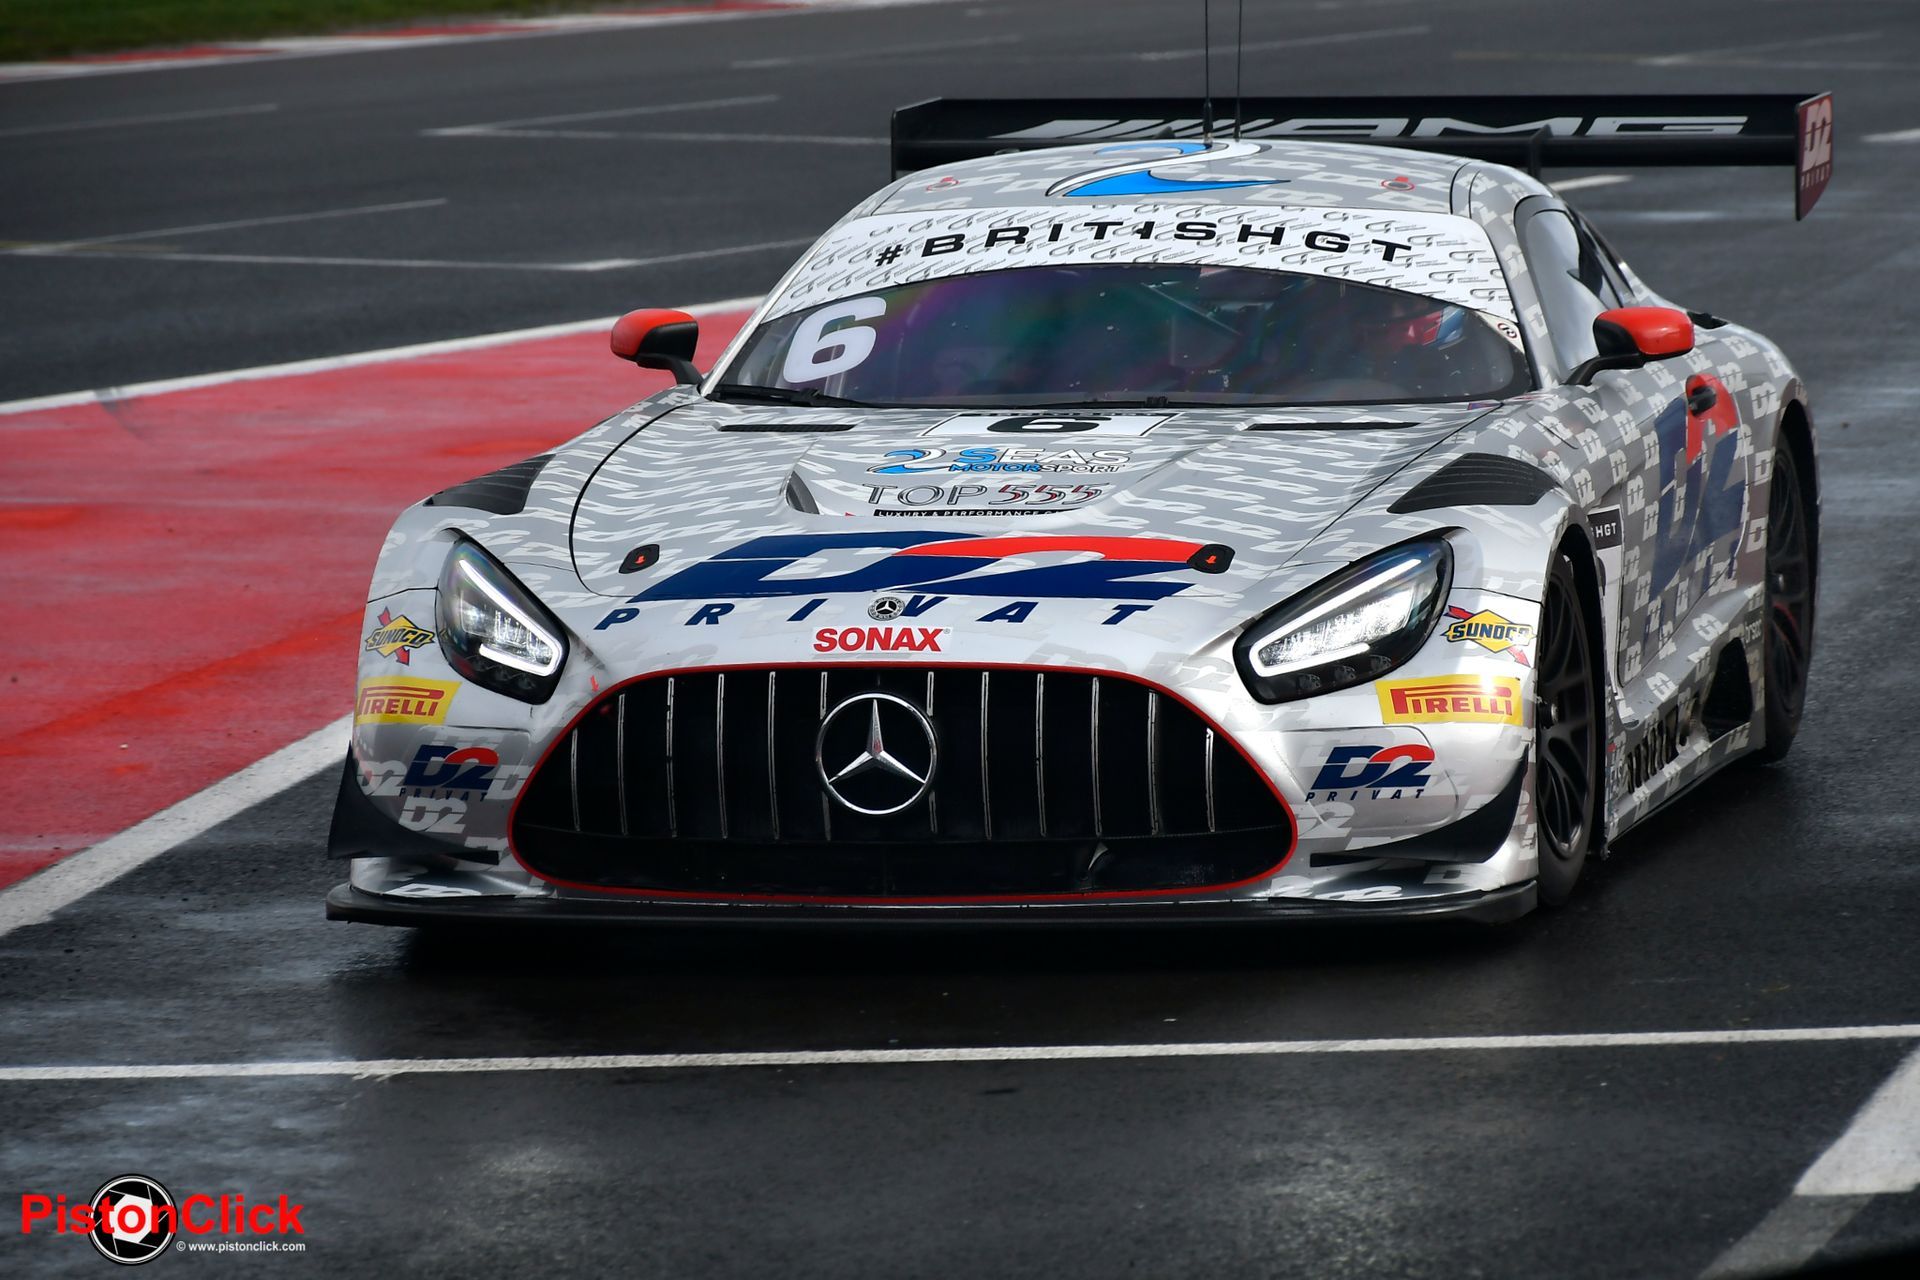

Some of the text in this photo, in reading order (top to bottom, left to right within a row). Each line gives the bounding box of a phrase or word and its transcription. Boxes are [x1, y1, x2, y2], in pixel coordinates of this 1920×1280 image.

[876, 220, 1412, 268] #BRITISHGT
[783, 296, 887, 383] 6
[986, 416, 1112, 433] 6
[949, 463, 1123, 473] MOTORSPORT
[952, 447, 1133, 464] SEAS
[862, 483, 1110, 506] TOP 555
[626, 530, 1204, 604] D2
[593, 593, 1152, 631] PRIVAT
[366, 628, 434, 649] SUNOCO
[813, 627, 943, 652] SONAX
[357, 686, 445, 717] PIRELLI
[1390, 684, 1512, 716] PIRELLI
[403, 744, 499, 791] D2
[1310, 744, 1436, 790] D2
[399, 787, 489, 802] PRIVAT
[1305, 789, 1425, 803] PRIVAT
